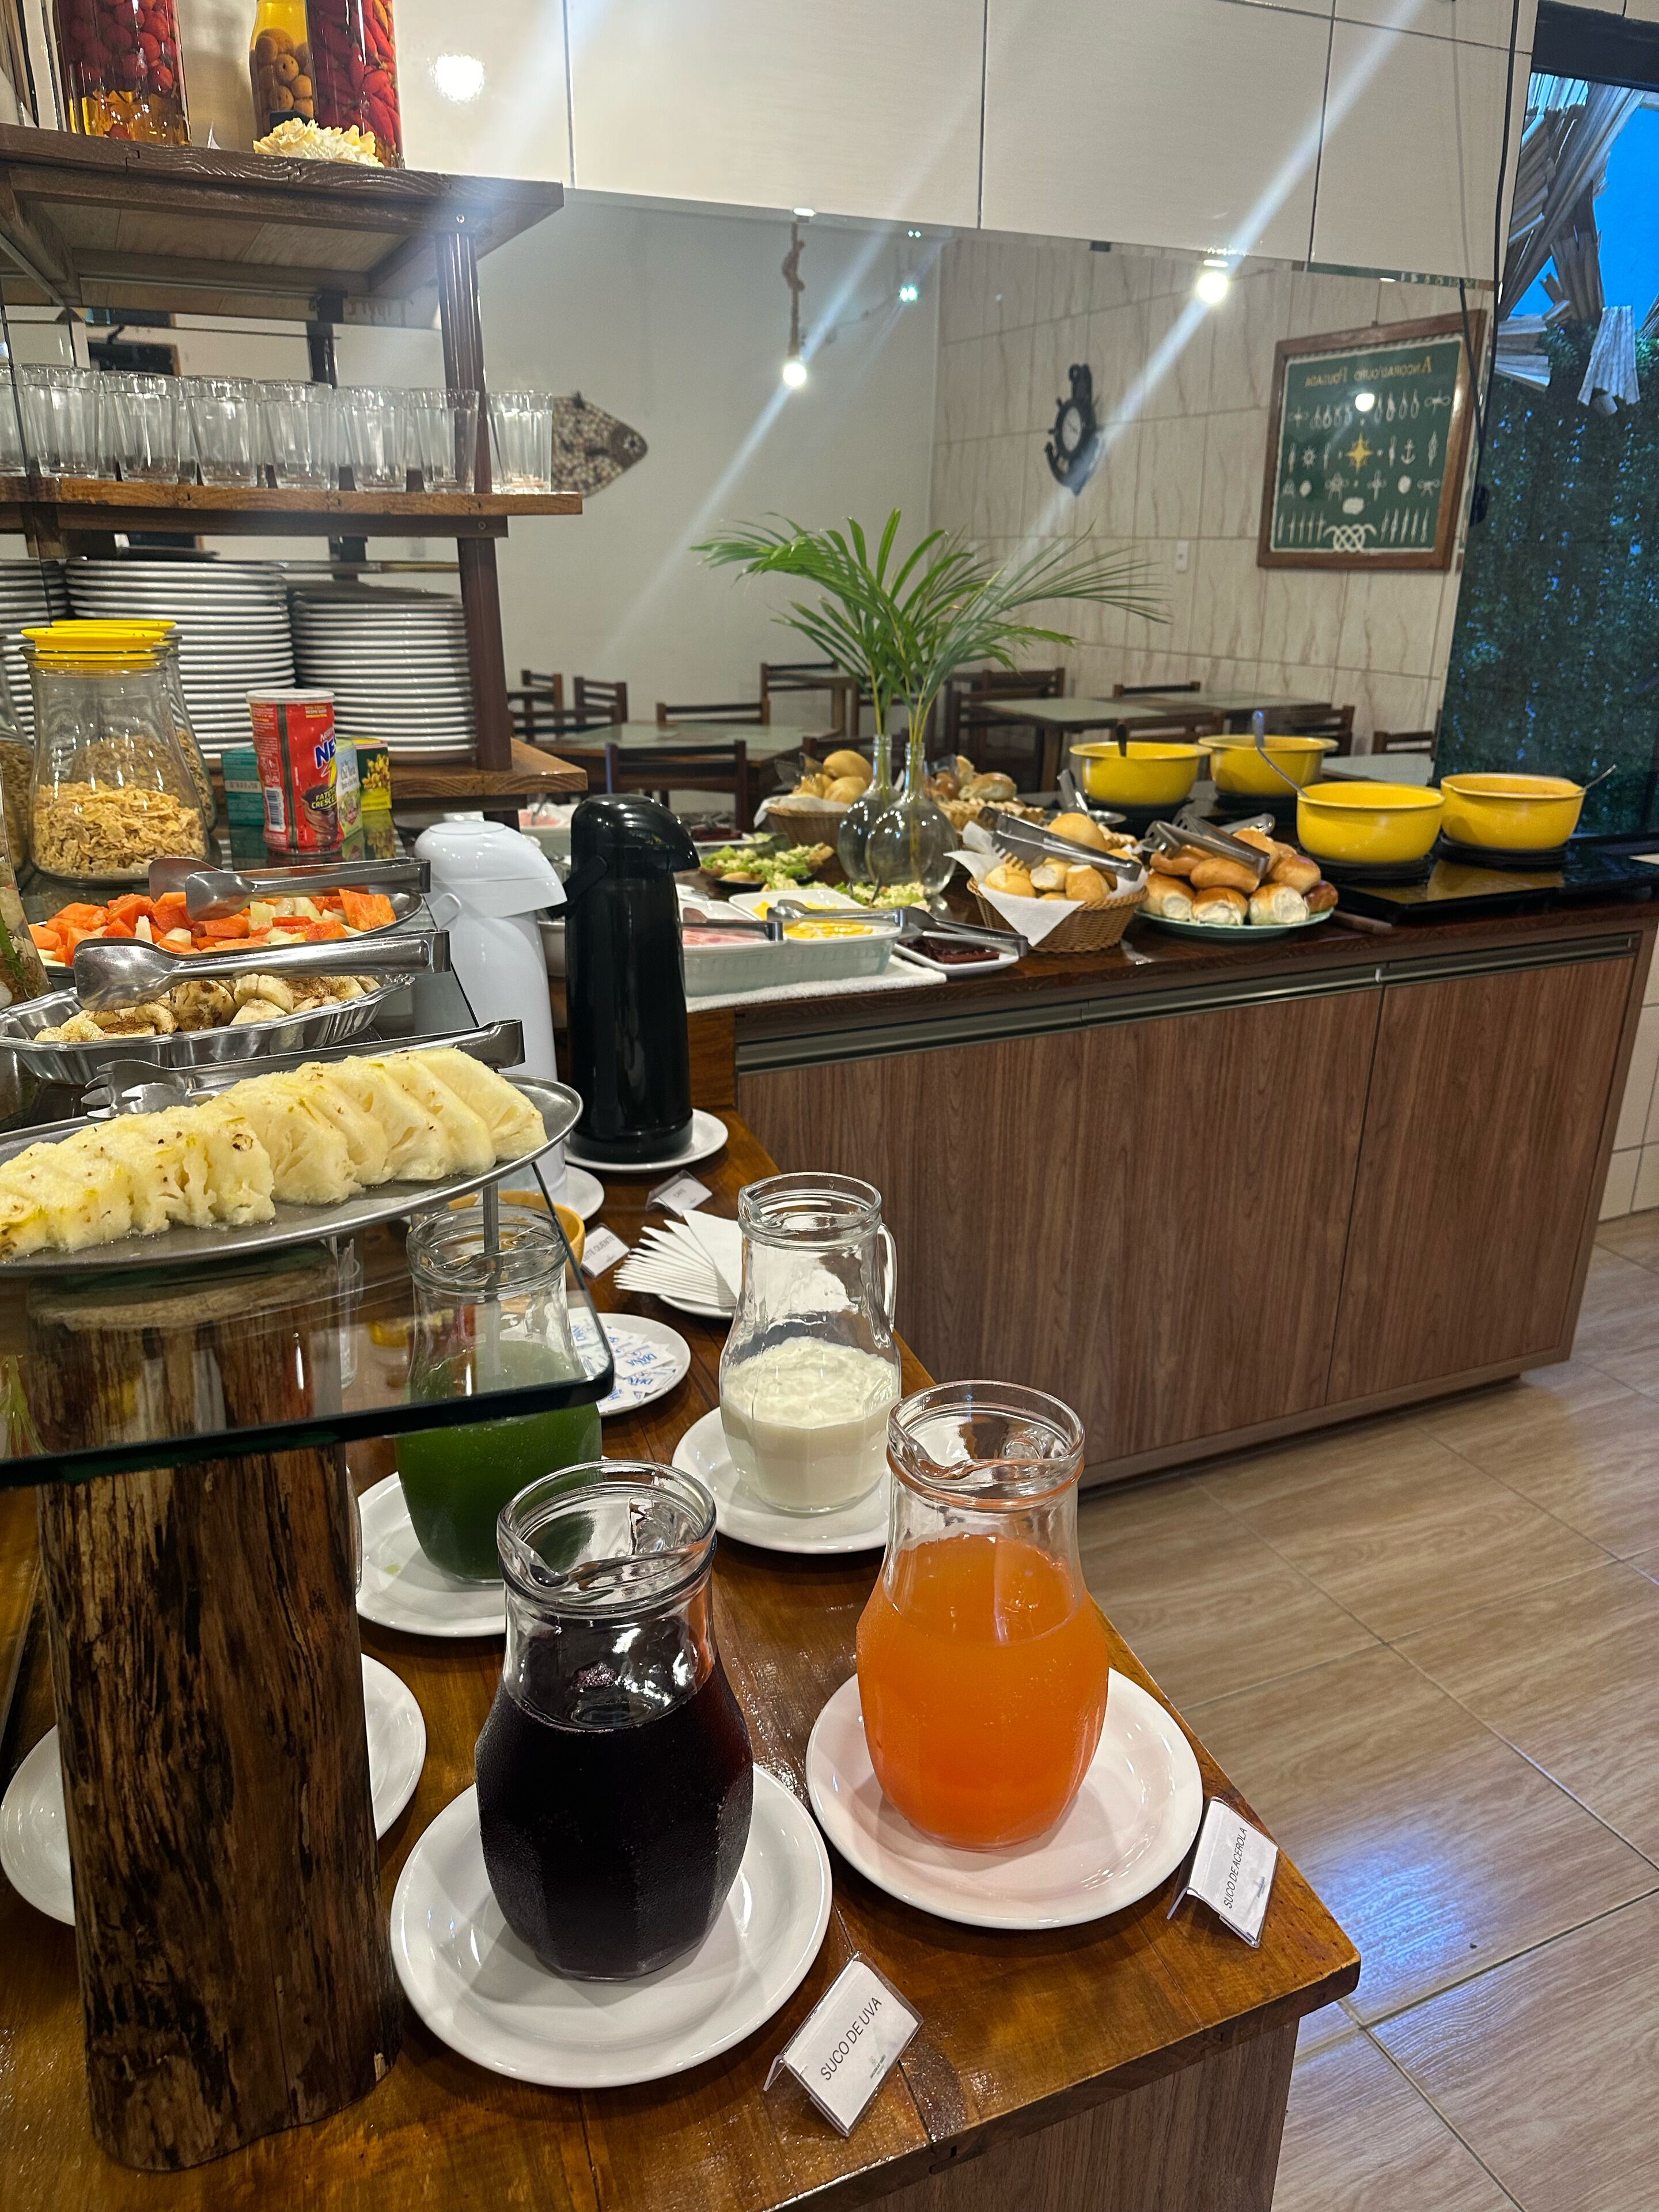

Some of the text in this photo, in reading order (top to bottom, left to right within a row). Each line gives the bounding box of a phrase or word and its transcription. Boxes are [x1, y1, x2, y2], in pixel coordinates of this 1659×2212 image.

[1224, 1827, 1247, 1908] SUCO DE ACEROLA
[820, 1997, 882, 2081] SUCO DE UVA
